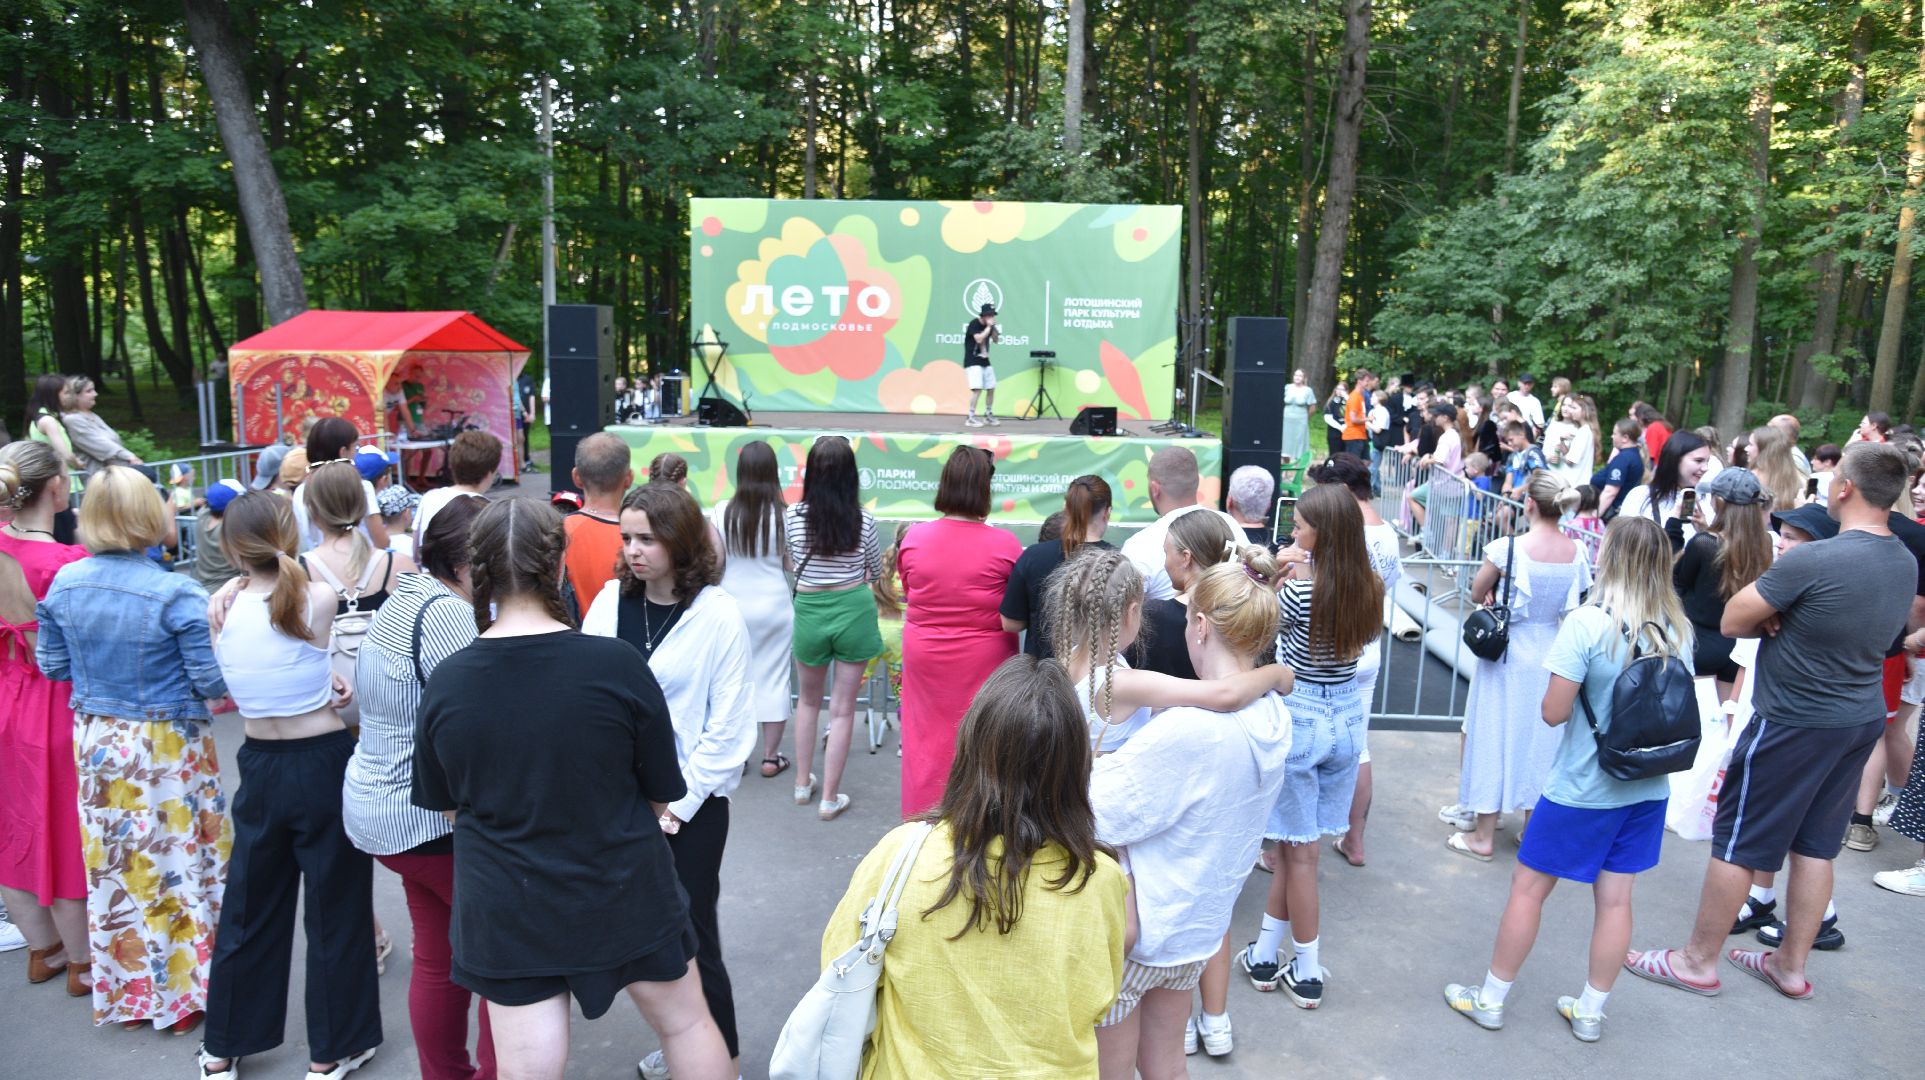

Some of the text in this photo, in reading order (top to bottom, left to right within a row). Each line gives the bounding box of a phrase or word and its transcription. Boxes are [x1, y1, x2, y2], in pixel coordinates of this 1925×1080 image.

[740, 284, 891, 318] лето
[1064, 298, 1142, 308] ЛОТОШИНСКИЙ
[1064, 309, 1140, 318] ПАРК КУЛЬТУРЫ
[772, 321, 873, 332] ПОДМОСКОВЬЕ
[1063, 319, 1114, 329] И ОТДЫХА
[877, 469, 916, 479] ПАРКИ
[991, 473, 1060, 484] ОТОШИНСКИЙ
